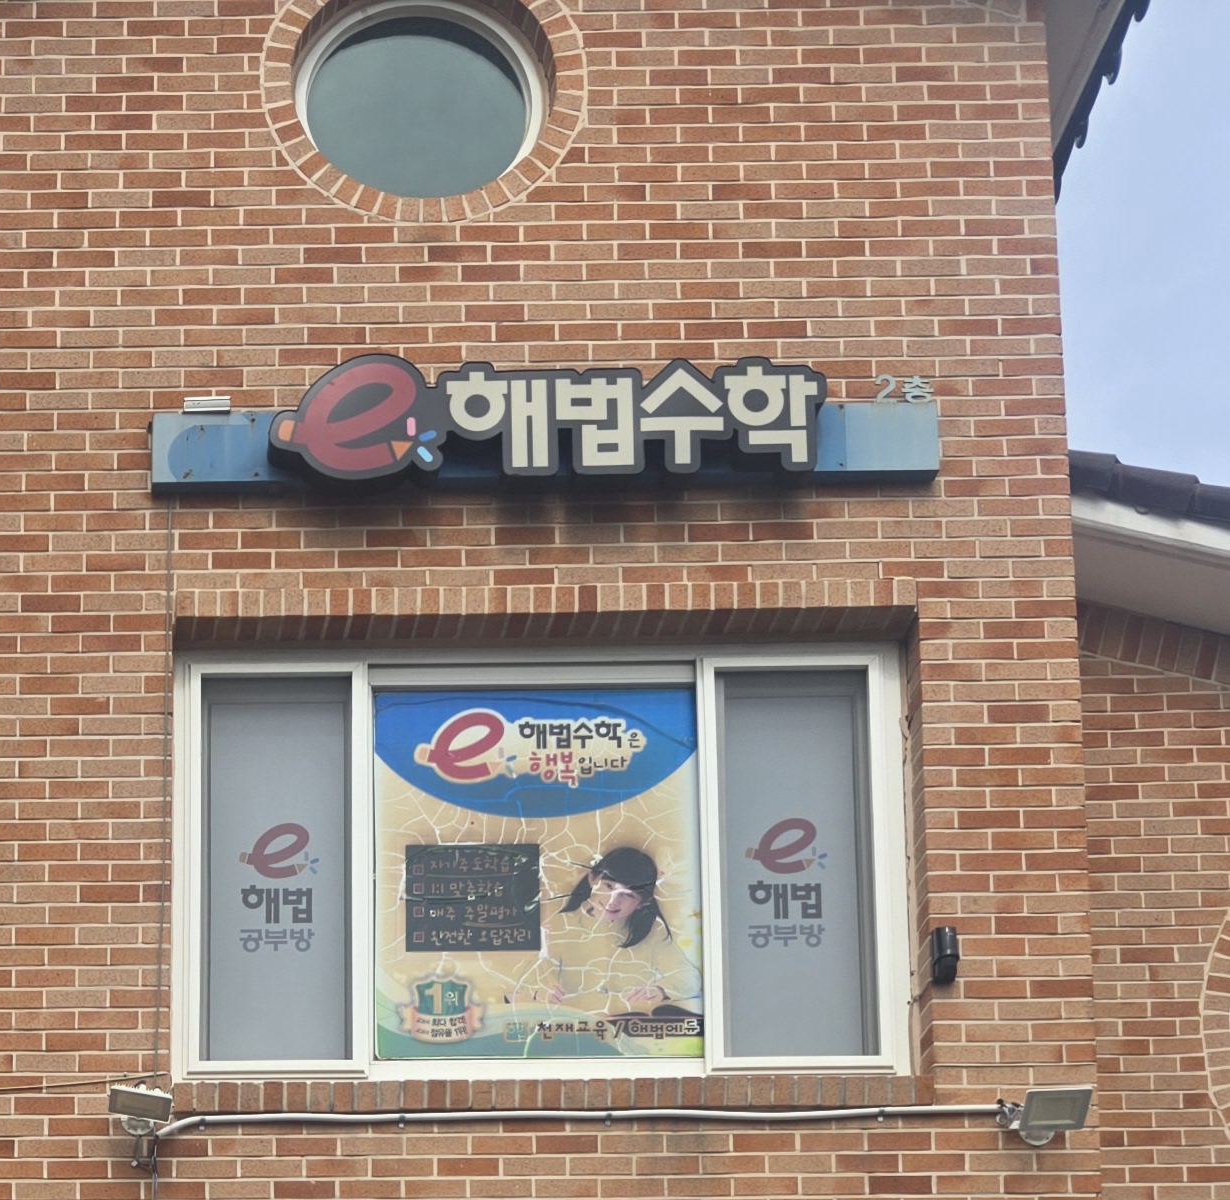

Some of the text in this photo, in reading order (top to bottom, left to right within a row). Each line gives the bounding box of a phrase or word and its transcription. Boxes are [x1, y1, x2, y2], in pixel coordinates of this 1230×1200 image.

[446, 366, 818, 468] 해법수학
[874, 374, 934, 403] 2층
[519, 721, 641, 749] 해법수학은
[529, 751, 627, 786] 행복입니다
[241, 885, 313, 924] 해법
[748, 880, 822, 919] 해법
[239, 928, 315, 953] 공부방
[748, 924, 825, 949] 공부방
[537, 1021, 608, 1041] 천재교육
[629, 1020, 699, 1039] 해법에듀
